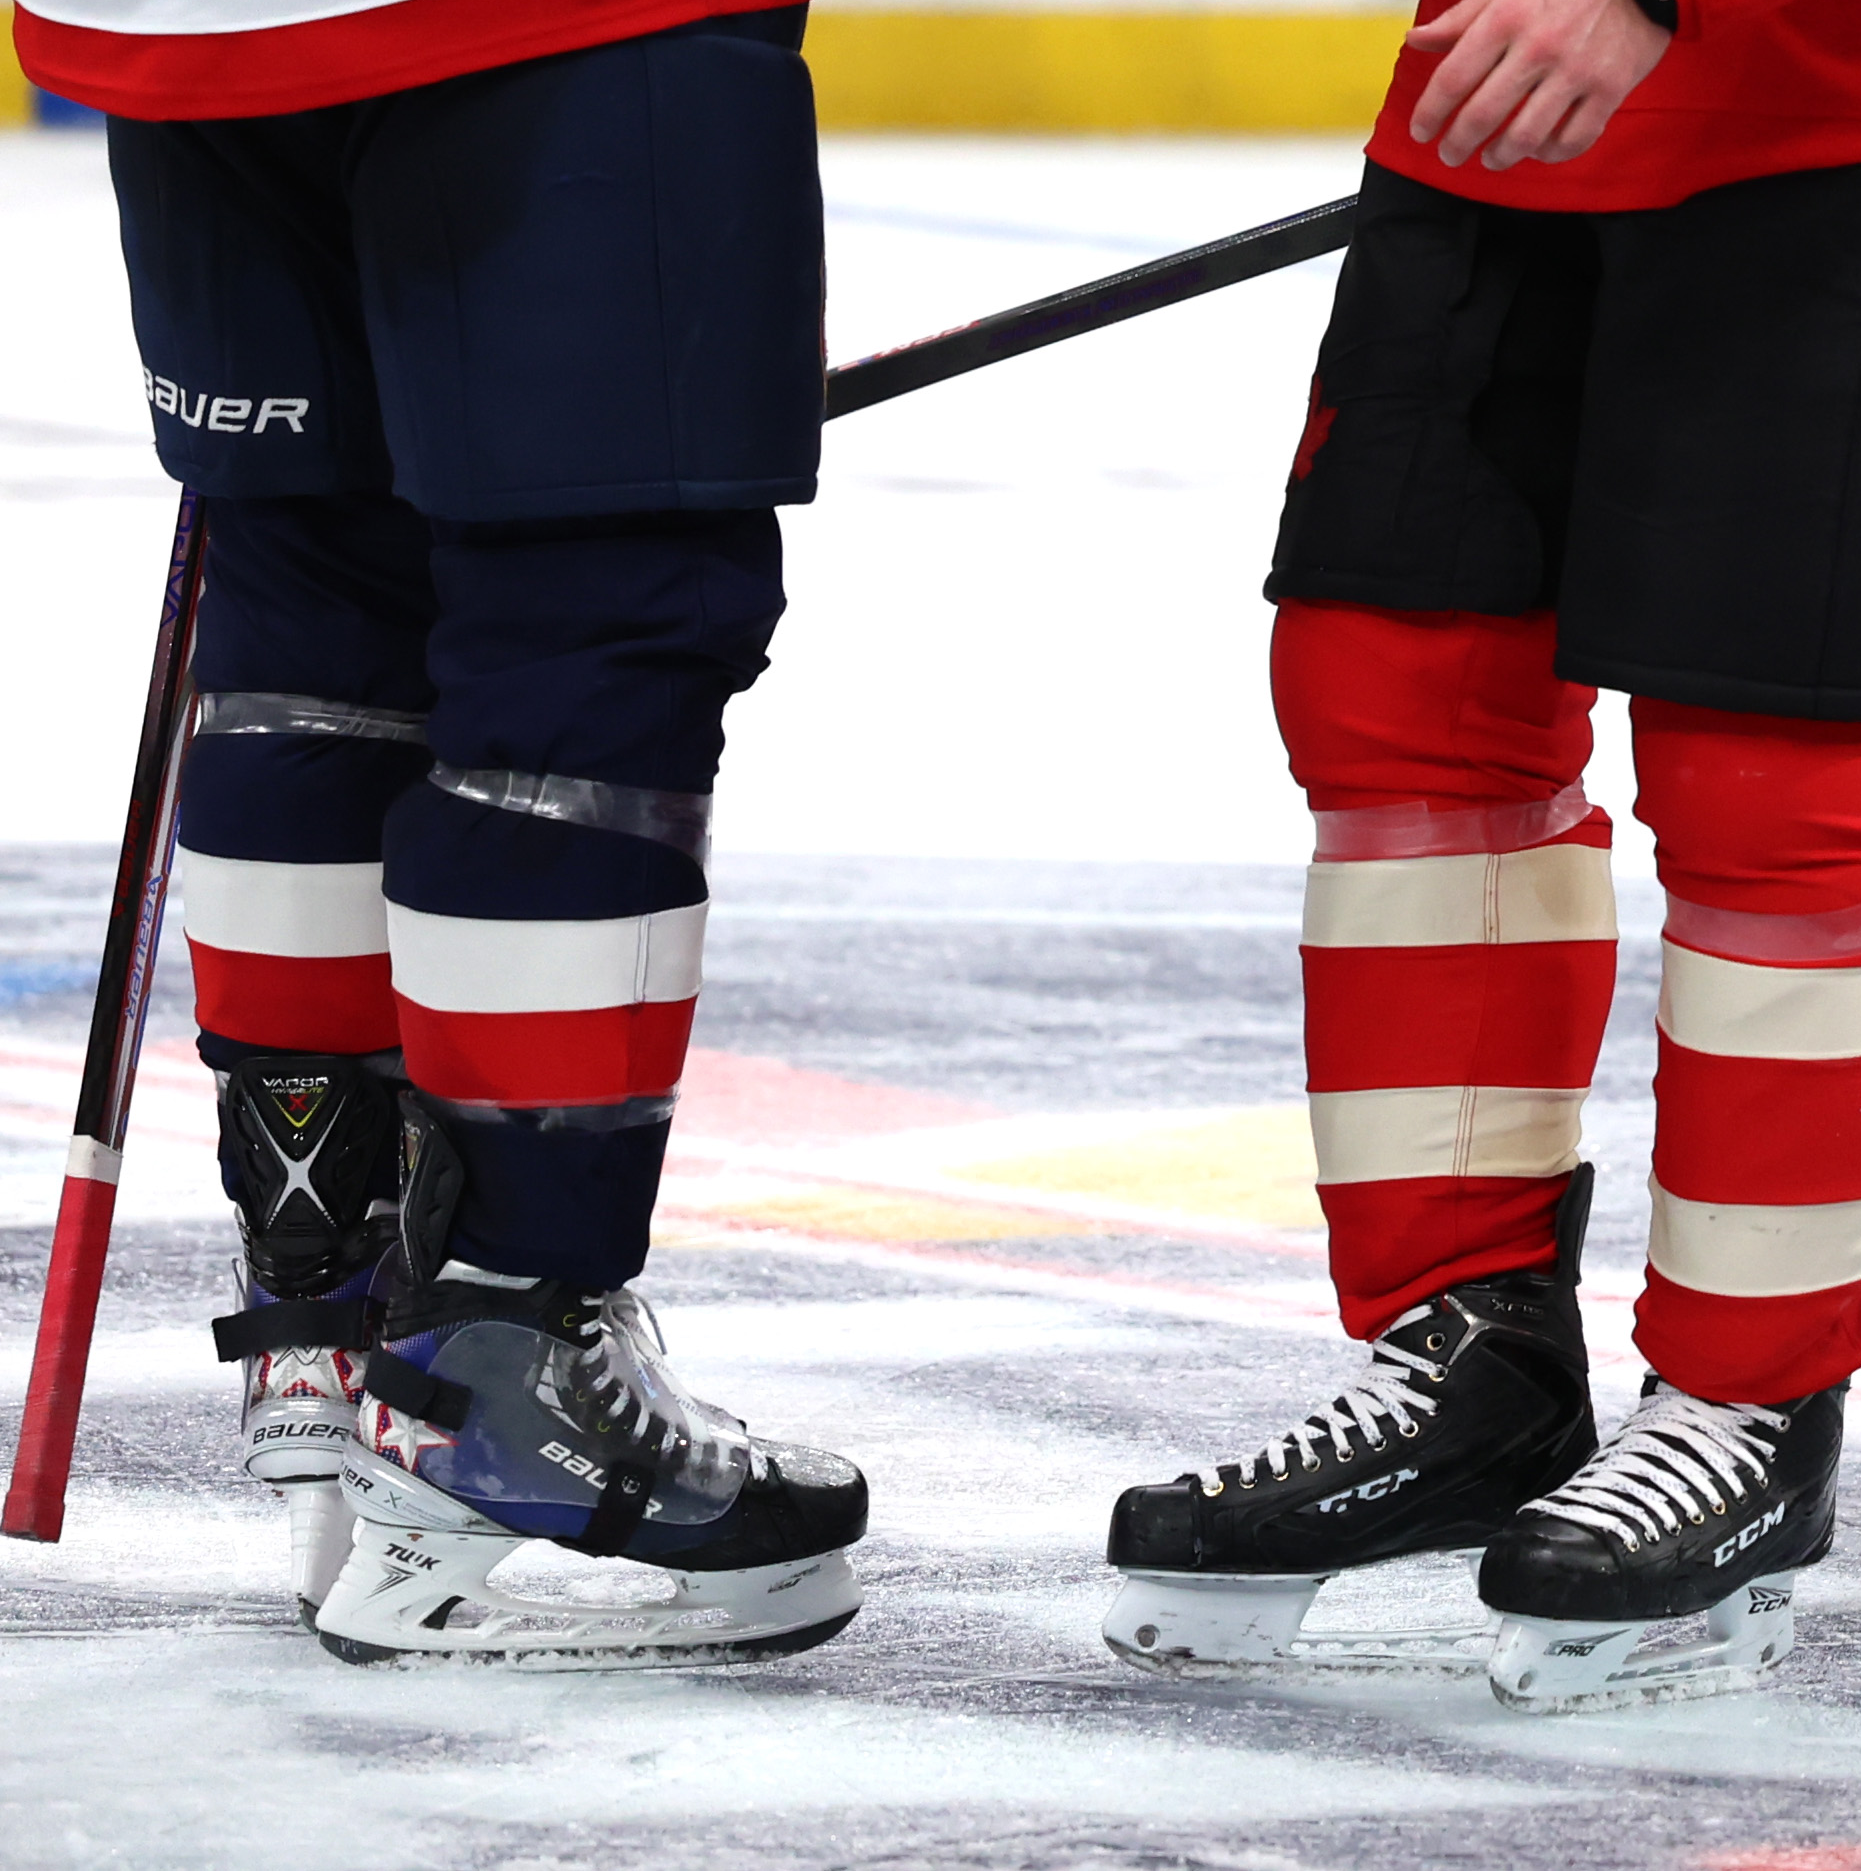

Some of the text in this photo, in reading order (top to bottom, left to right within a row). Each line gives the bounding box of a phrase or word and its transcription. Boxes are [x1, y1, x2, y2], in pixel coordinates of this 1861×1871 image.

[160, 484, 199, 628] VAPO
[252, 1419, 350, 1446] BAUER
[1713, 1500, 1786, 1569] CCM
[1748, 1597, 1792, 1615] CCM
